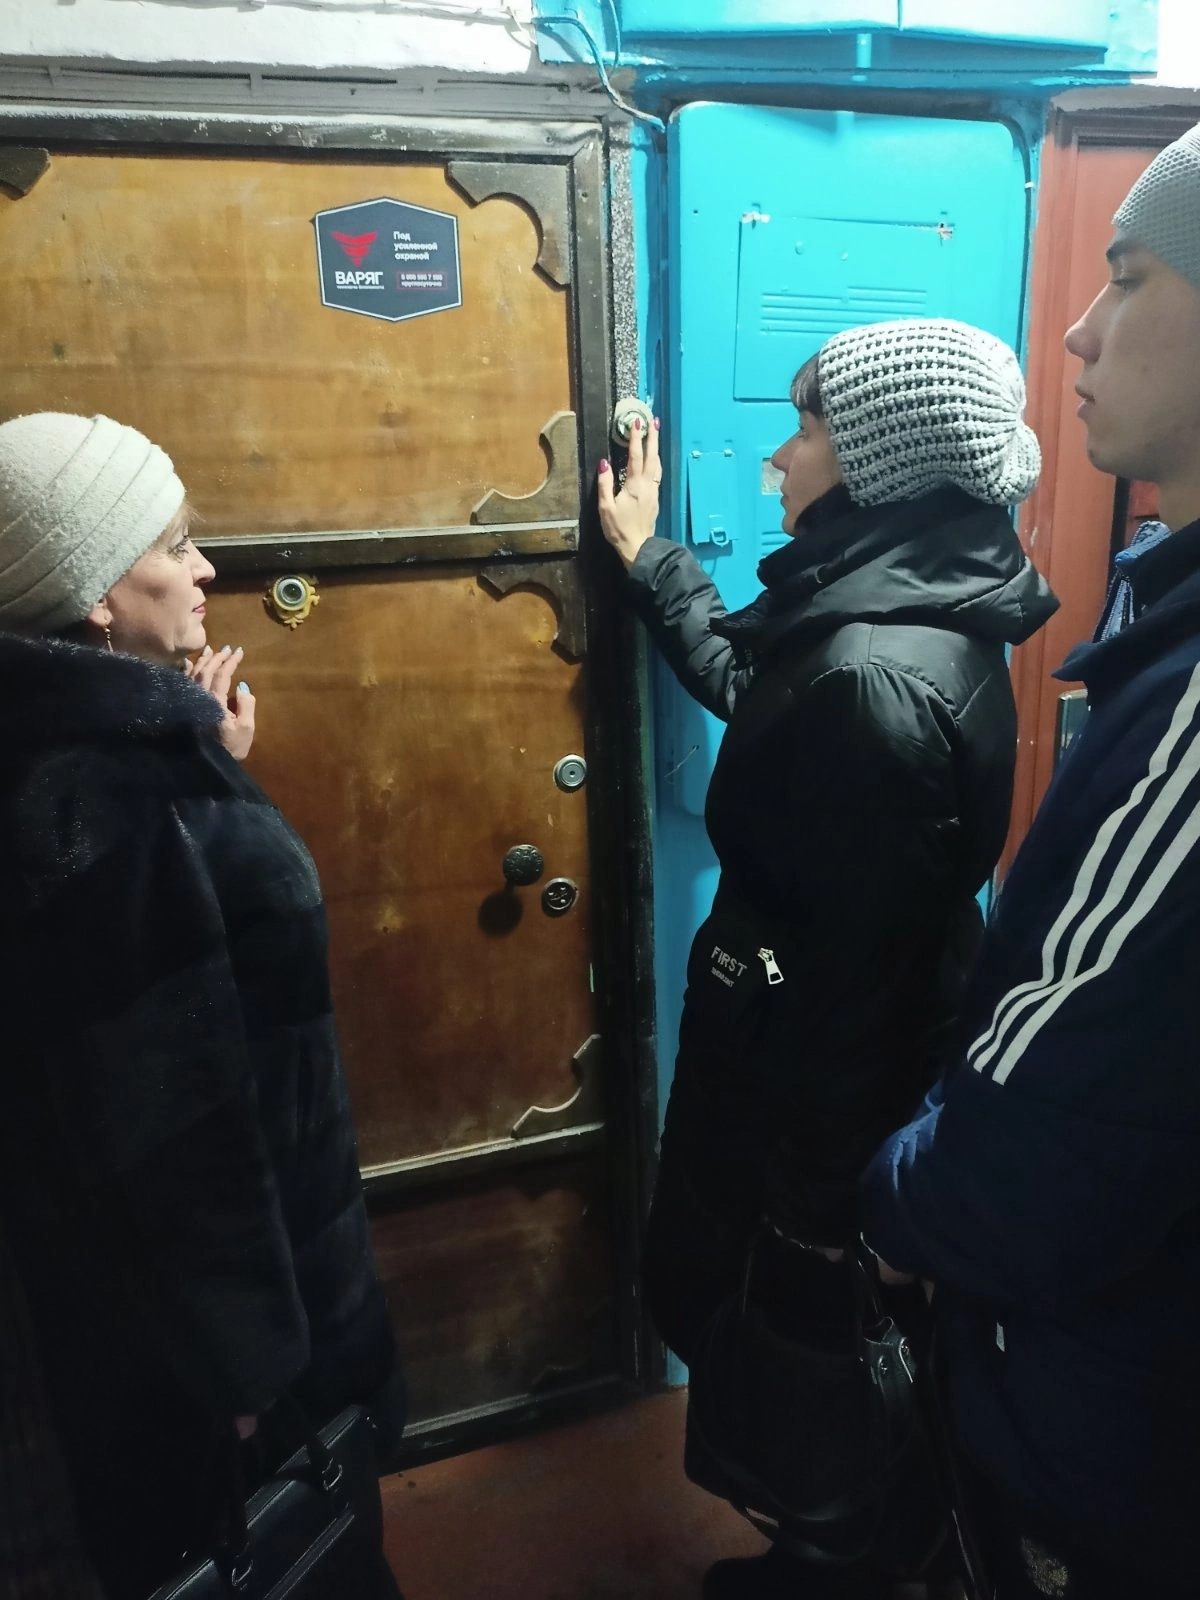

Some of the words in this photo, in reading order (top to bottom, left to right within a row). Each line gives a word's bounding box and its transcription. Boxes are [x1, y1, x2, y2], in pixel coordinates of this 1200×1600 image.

[393, 231, 411, 241] Под
[393, 242, 438, 251] усиленной
[394, 252, 429, 261] охраной
[335, 271, 383, 284] ВАРЯГ
[711, 945, 748, 977] FIRST
